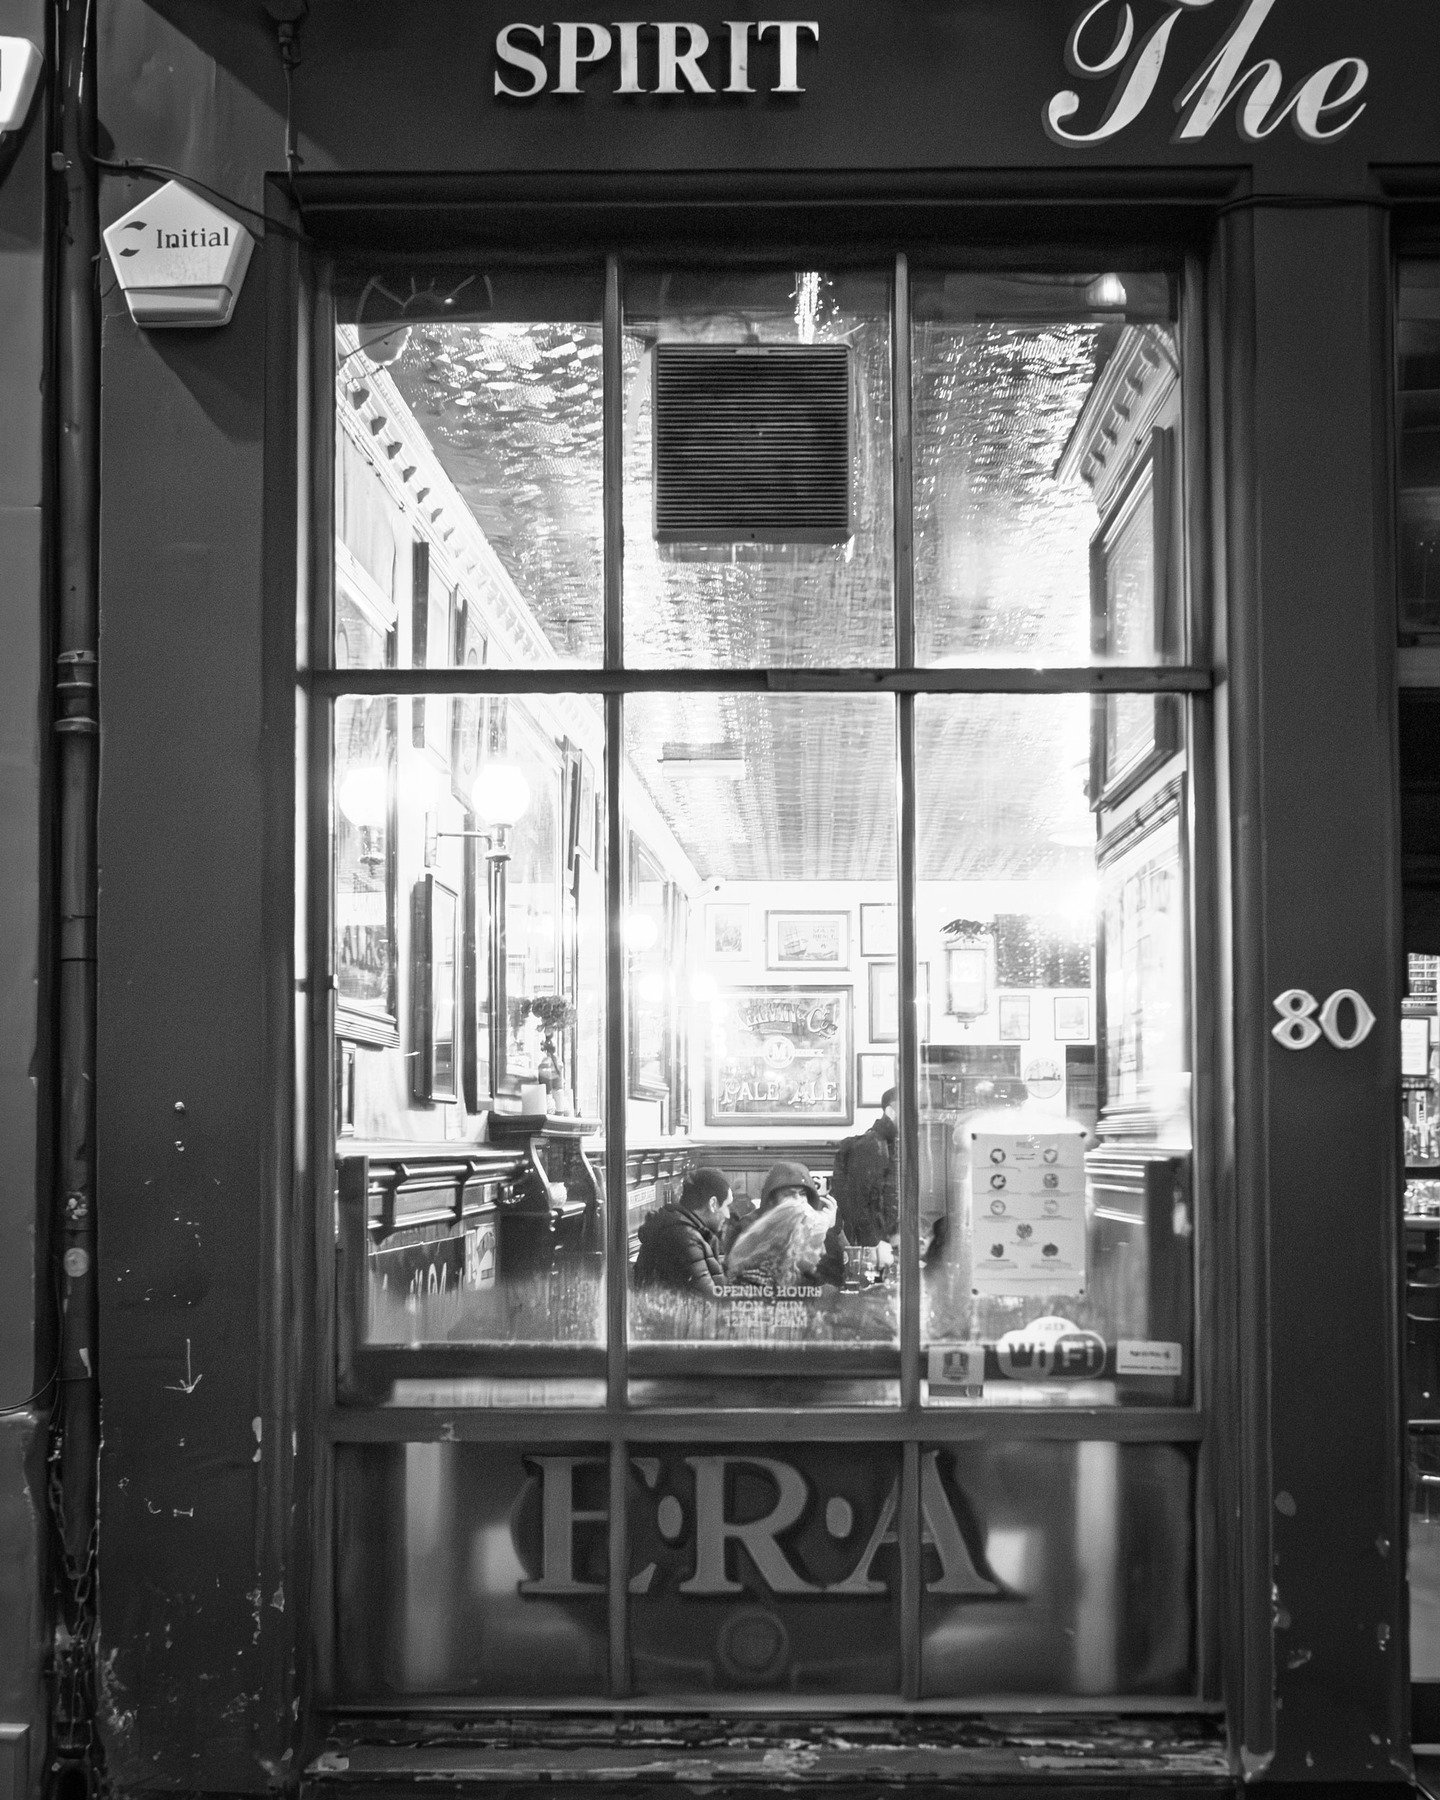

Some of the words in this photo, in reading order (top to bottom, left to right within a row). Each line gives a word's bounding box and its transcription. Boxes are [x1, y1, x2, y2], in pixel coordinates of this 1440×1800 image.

[493, 20, 820, 97] SPIRIT
[1045, 0, 1371, 143] The
[155, 226, 230, 250] Initial
[1271, 988, 1377, 1050] 80
[712, 1285, 774, 1297] OPENING
[1008, 1340, 1096, 1369] WiFi
